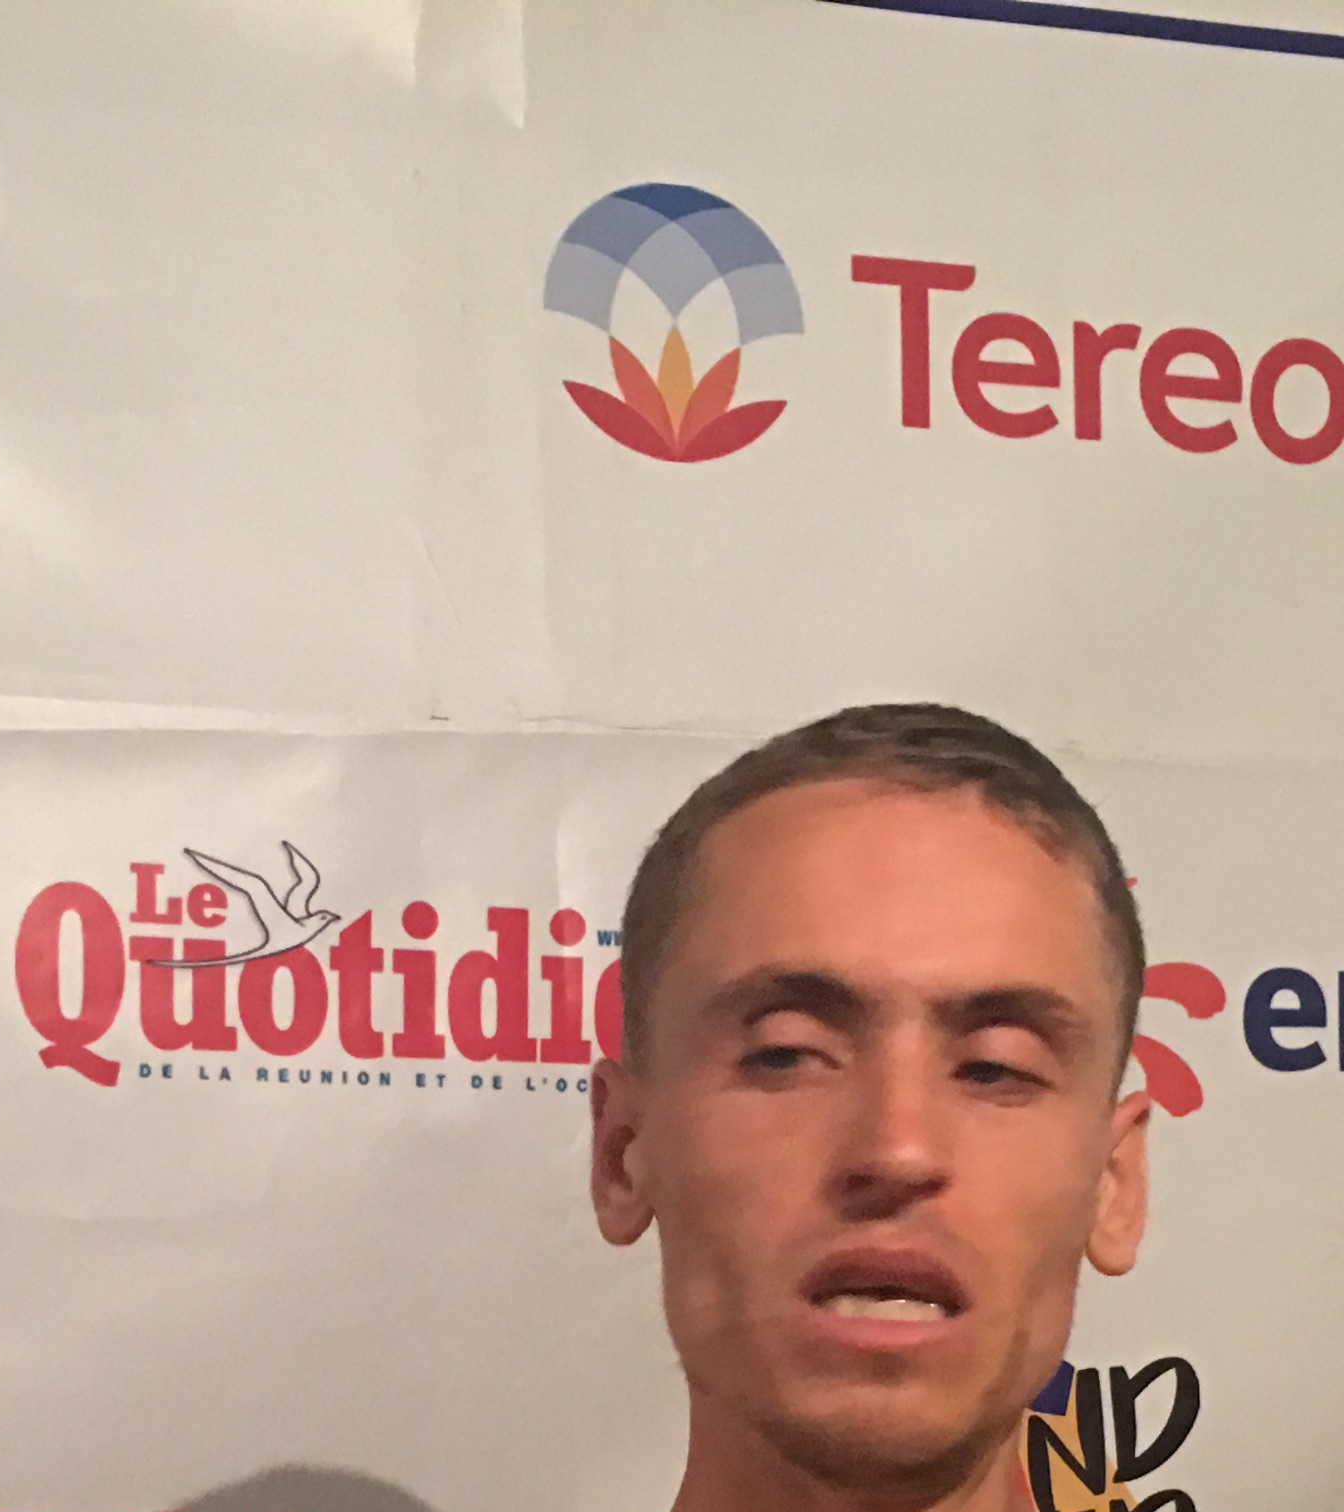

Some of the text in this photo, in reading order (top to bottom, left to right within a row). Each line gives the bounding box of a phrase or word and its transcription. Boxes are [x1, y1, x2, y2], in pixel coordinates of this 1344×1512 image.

[129, 862, 228, 927] Le
[139, 1063, 173, 1079] DE
[199, 1065, 232, 1082] LA
[256, 1067, 392, 1087] REUNION
[416, 1072, 447, 1089] ET
[471, 1074, 503, 1091] DE
